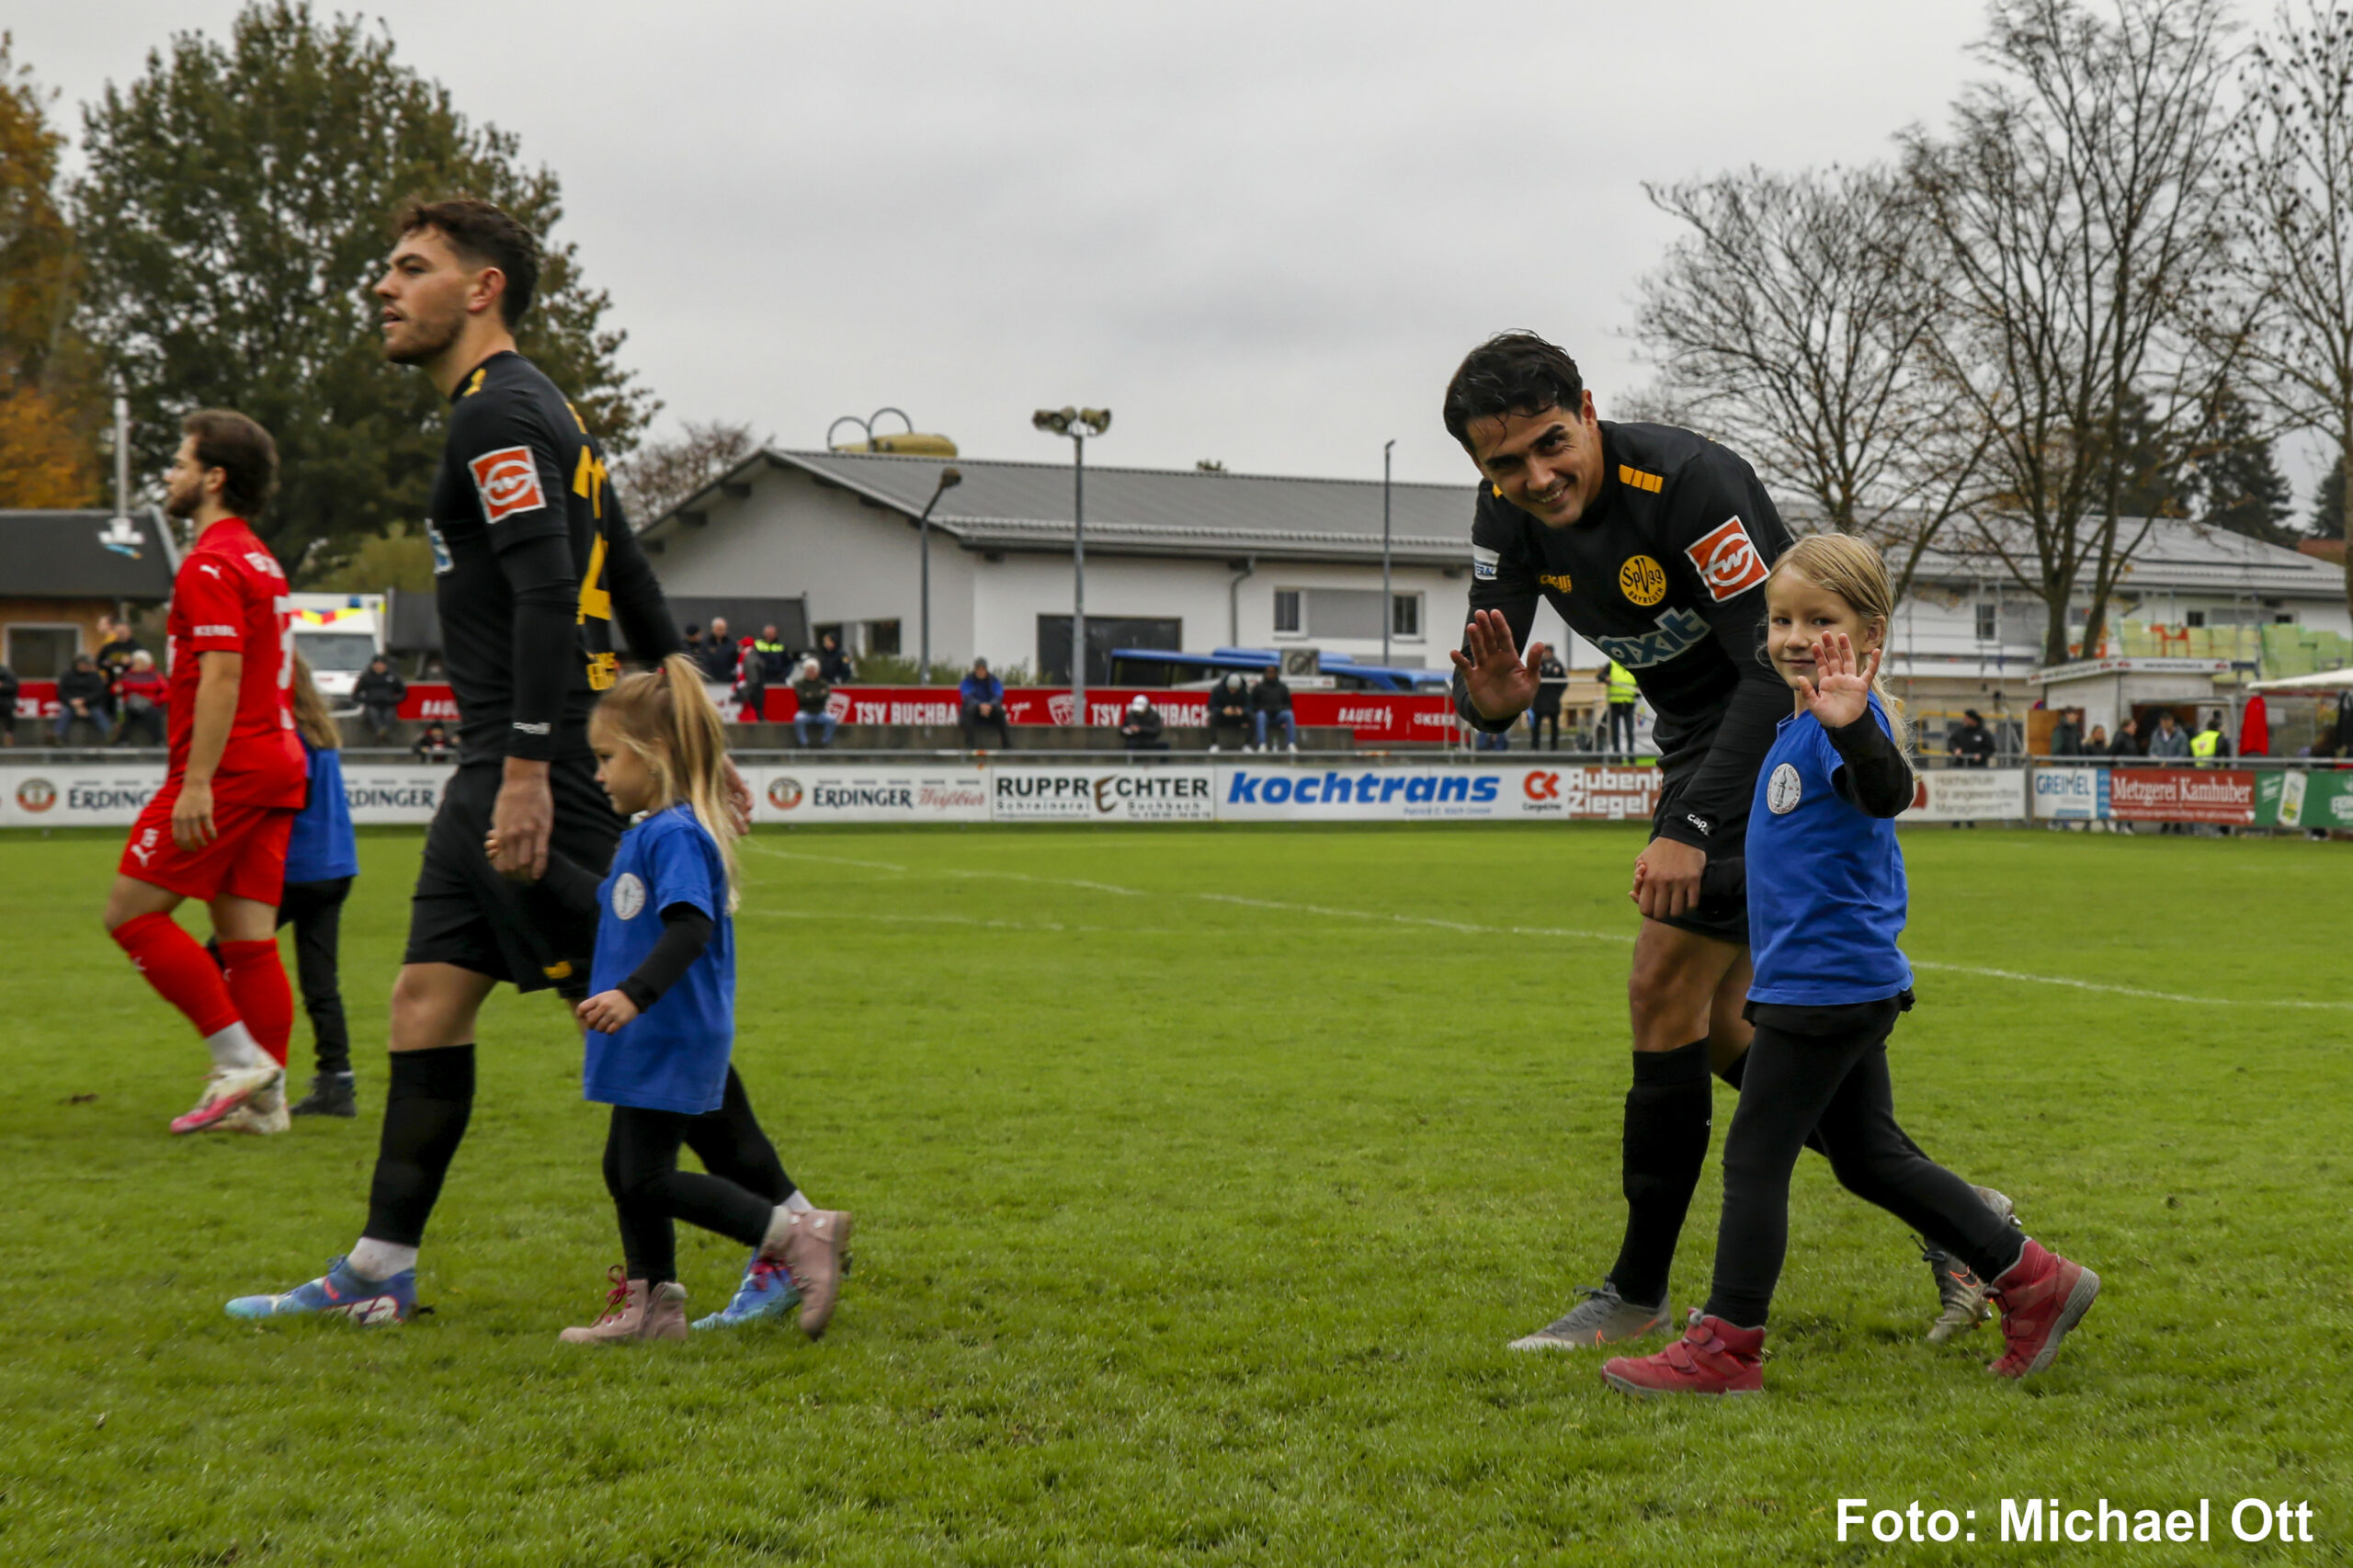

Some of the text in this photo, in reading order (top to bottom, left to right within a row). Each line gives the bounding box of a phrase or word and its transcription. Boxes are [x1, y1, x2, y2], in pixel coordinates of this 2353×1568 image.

[854, 702, 886, 724] TSV
[890, 702, 958, 725] BUCHBA
[1091, 703, 1122, 726] TSV
[1338, 707, 1384, 723] BAUER
[346, 788, 436, 810] RDINGER
[813, 787, 913, 809] ERDINGER
[1227, 772, 1501, 804] kochtrans
[2113, 777, 2177, 806] Metzgerei
[1128, 801, 1199, 811] Buchbach
